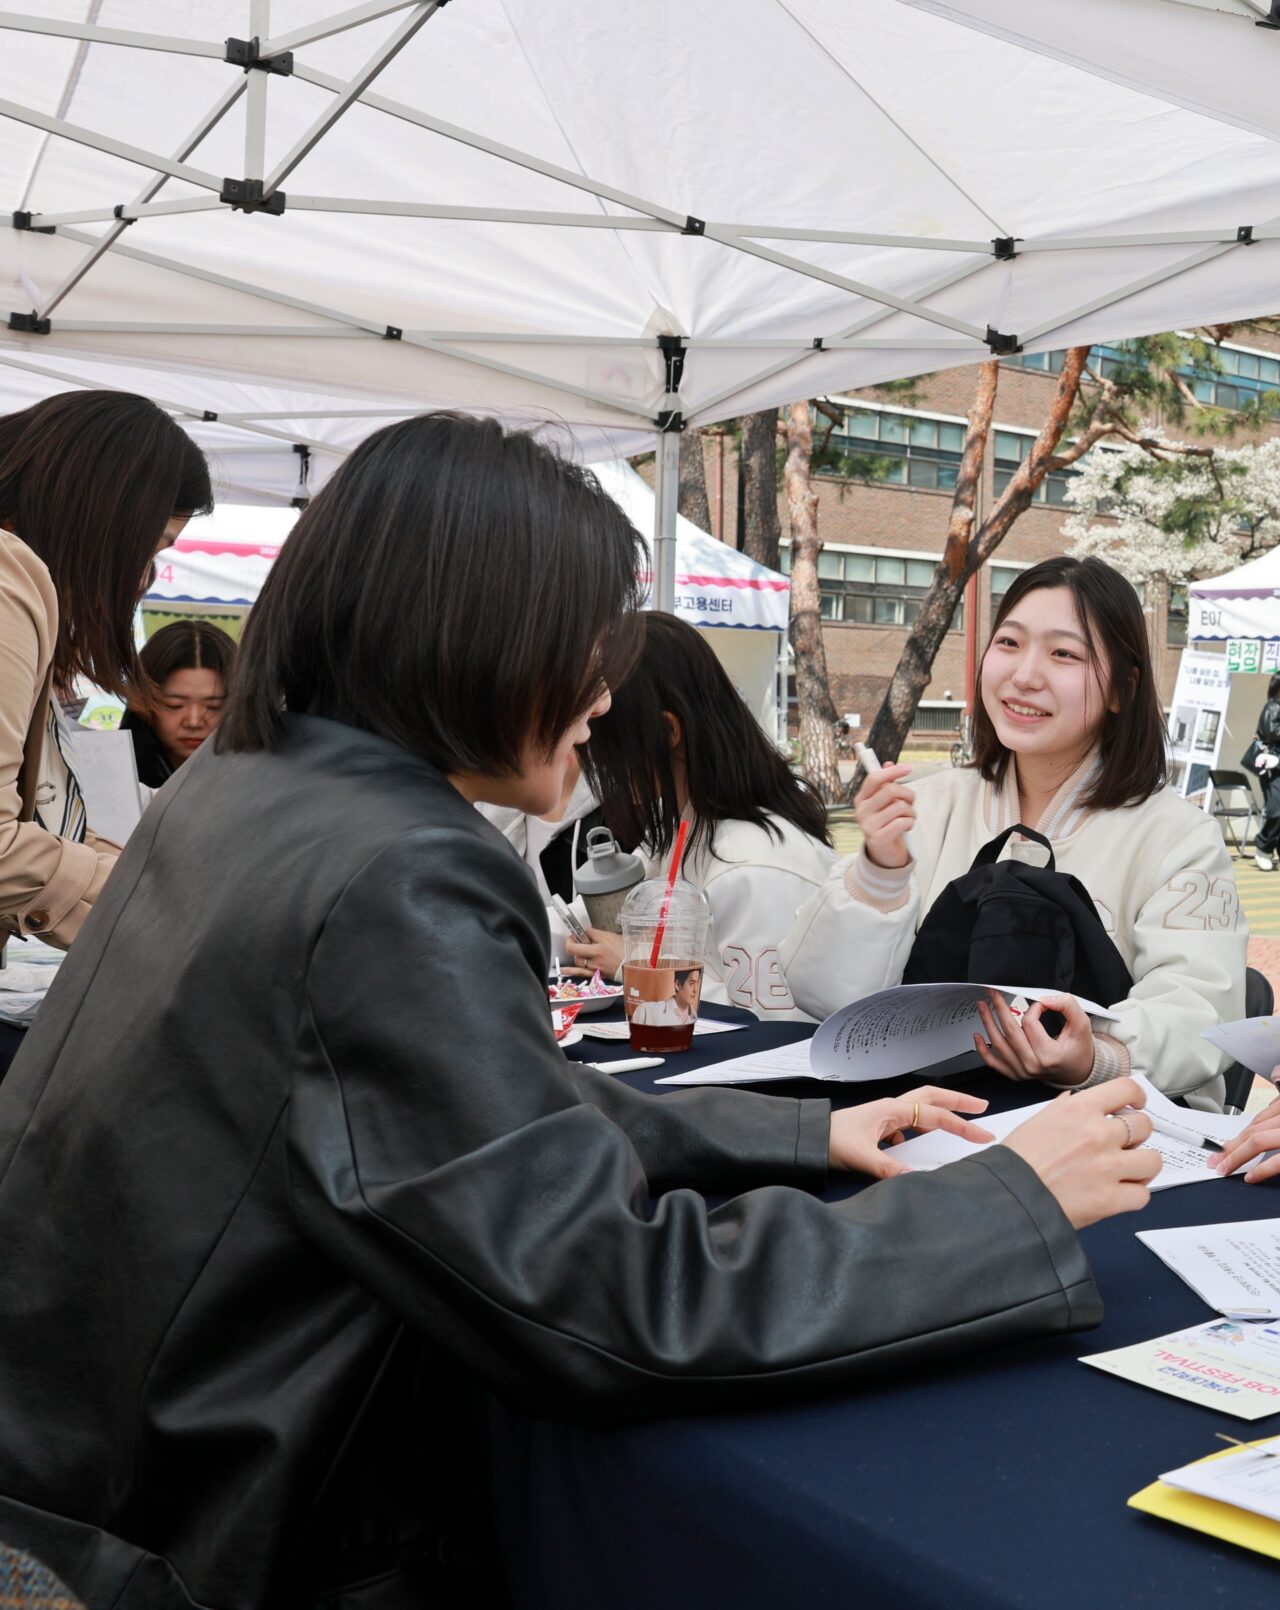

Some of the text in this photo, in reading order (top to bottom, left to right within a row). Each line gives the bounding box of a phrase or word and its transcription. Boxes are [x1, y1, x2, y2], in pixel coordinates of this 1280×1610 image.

[1228, 642, 1258, 671] 현장
[1163, 868, 1240, 932] 23
[1153, 1349, 1245, 1384] FESTIVAL
